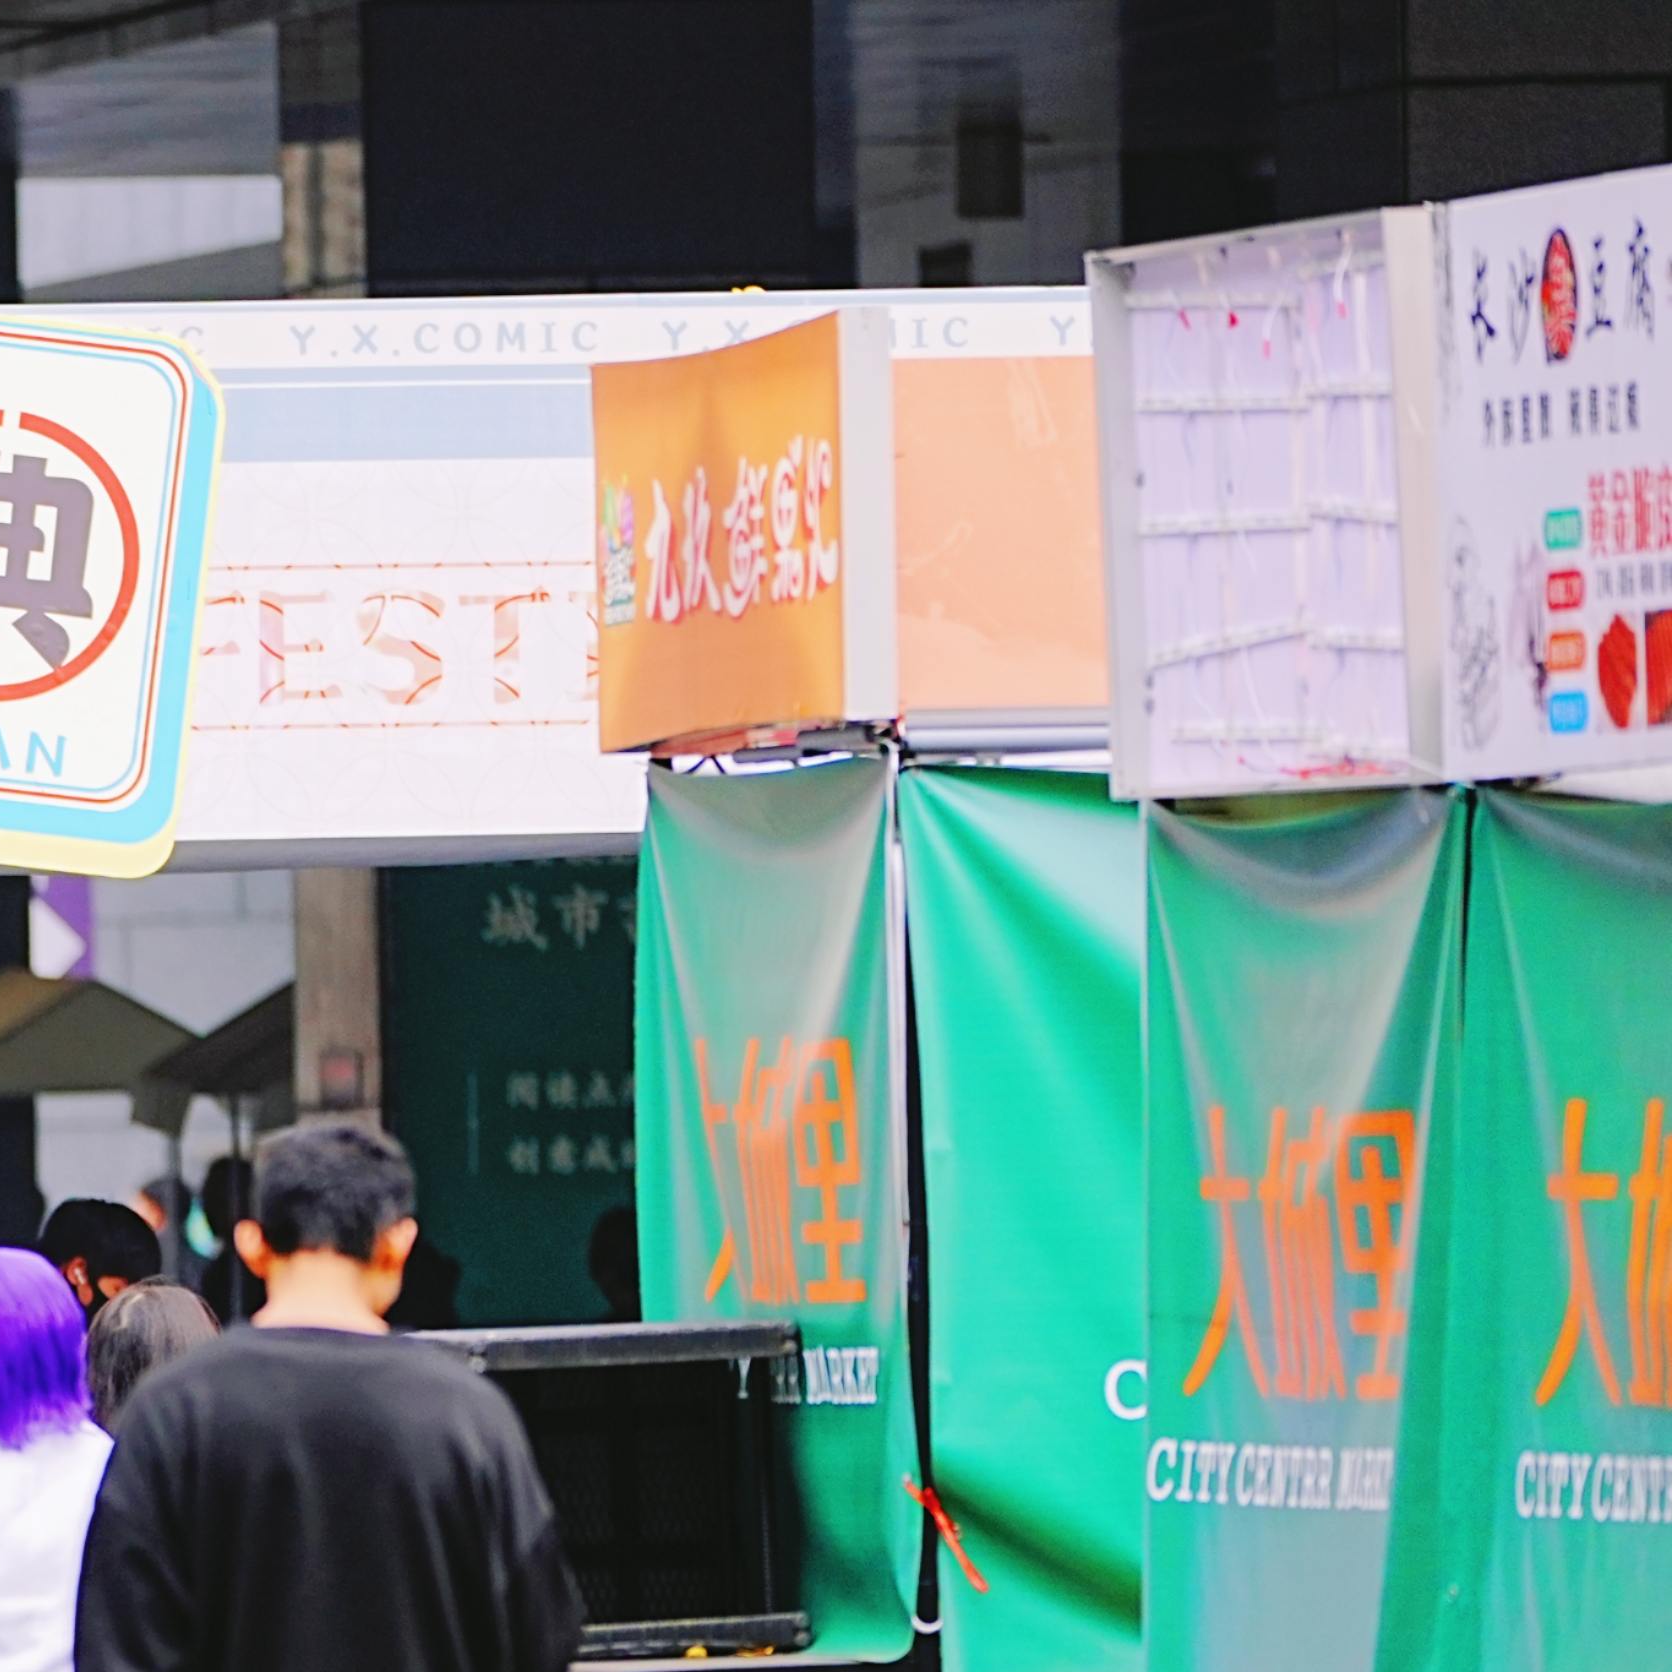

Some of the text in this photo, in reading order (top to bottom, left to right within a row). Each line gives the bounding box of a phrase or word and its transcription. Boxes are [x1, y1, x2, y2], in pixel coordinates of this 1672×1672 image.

[289, 321, 598, 358] Y.X.COMIC
[1146, 1437, 1236, 1504] CITY
[1515, 1449, 1592, 1519] CITY
